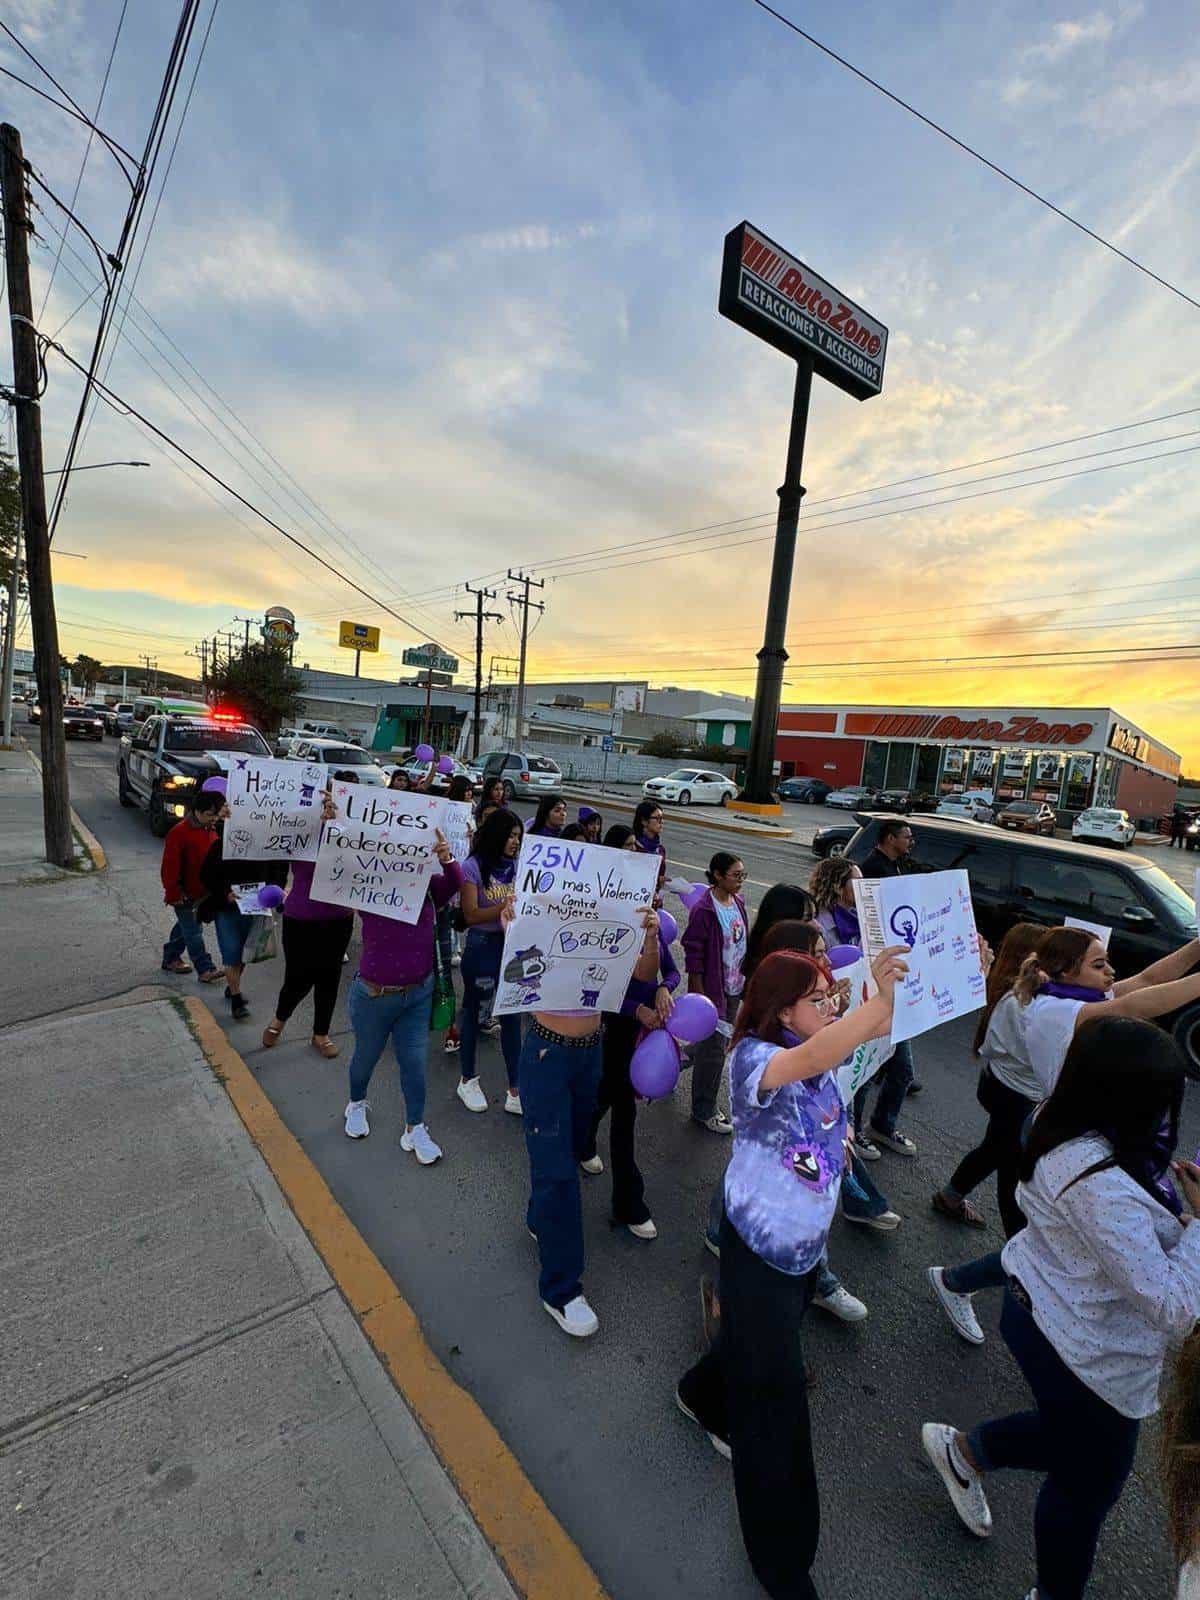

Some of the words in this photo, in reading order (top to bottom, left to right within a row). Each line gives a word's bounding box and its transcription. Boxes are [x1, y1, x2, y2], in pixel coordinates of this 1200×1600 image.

[777, 268, 881, 357] AutoZone
[744, 279, 814, 340] REFACCIONES
[818, 329, 825, 344] Y
[826, 337, 879, 381] ACCESORIOS
[930, 716, 1093, 745] AutoZone
[233, 795, 245, 806] de
[253, 793, 287, 808] Vivir
[346, 796, 428, 830] Libres
[269, 810, 306, 828] Miedo
[326, 826, 429, 858] Poderosas
[526, 843, 585, 872] 25N
[353, 872, 383, 885] sin
[522, 869, 555, 893] NO
[562, 879, 592, 893] mas
[597, 867, 651, 903] Violencia
[350, 886, 404, 907] Miedo
[520, 902, 541, 916] las
[559, 927, 630, 954] Basta!
